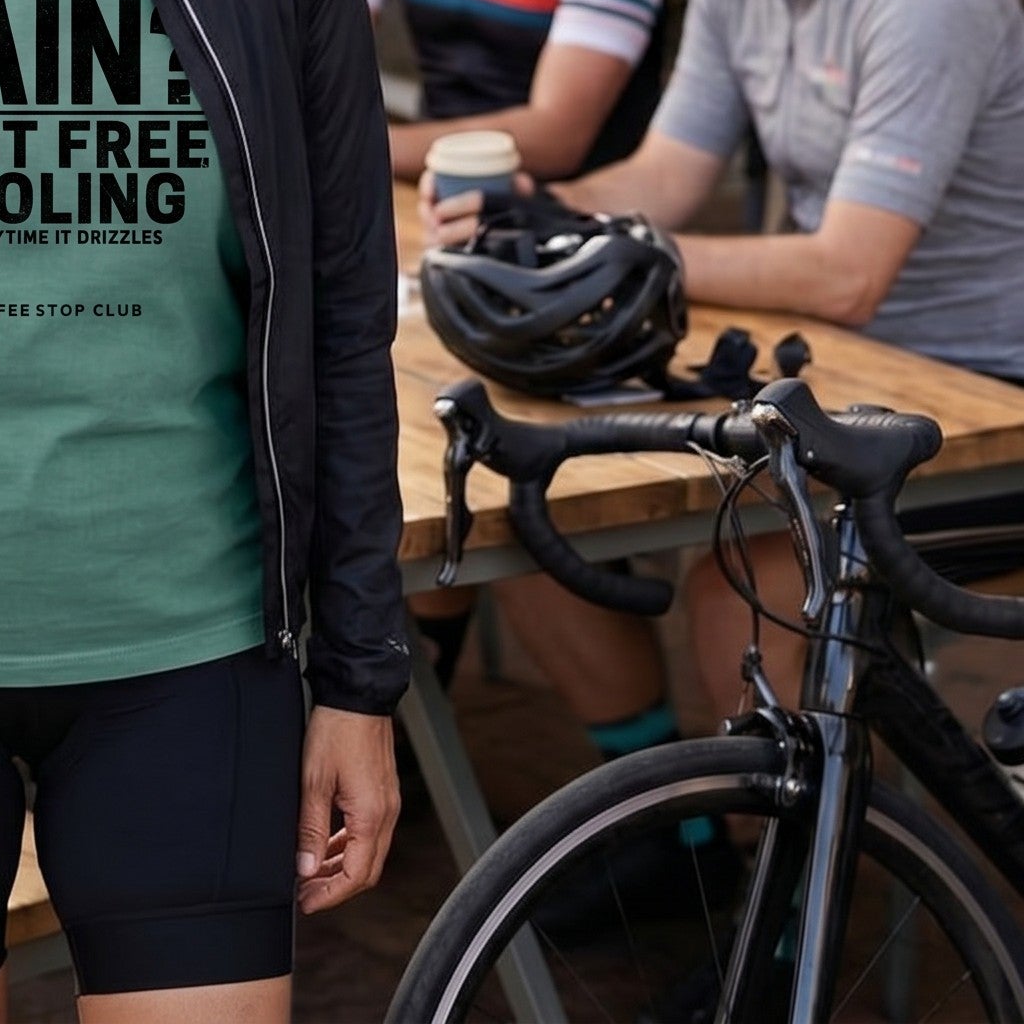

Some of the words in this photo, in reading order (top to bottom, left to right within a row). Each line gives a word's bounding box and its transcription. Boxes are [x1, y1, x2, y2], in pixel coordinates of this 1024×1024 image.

[58, 120, 210, 168] FREE
[55, 229, 72, 245] IT
[77, 229, 163, 245] DRIZZLES
[36, 303, 85, 317] STOP
[92, 303, 142, 317] CLUB
